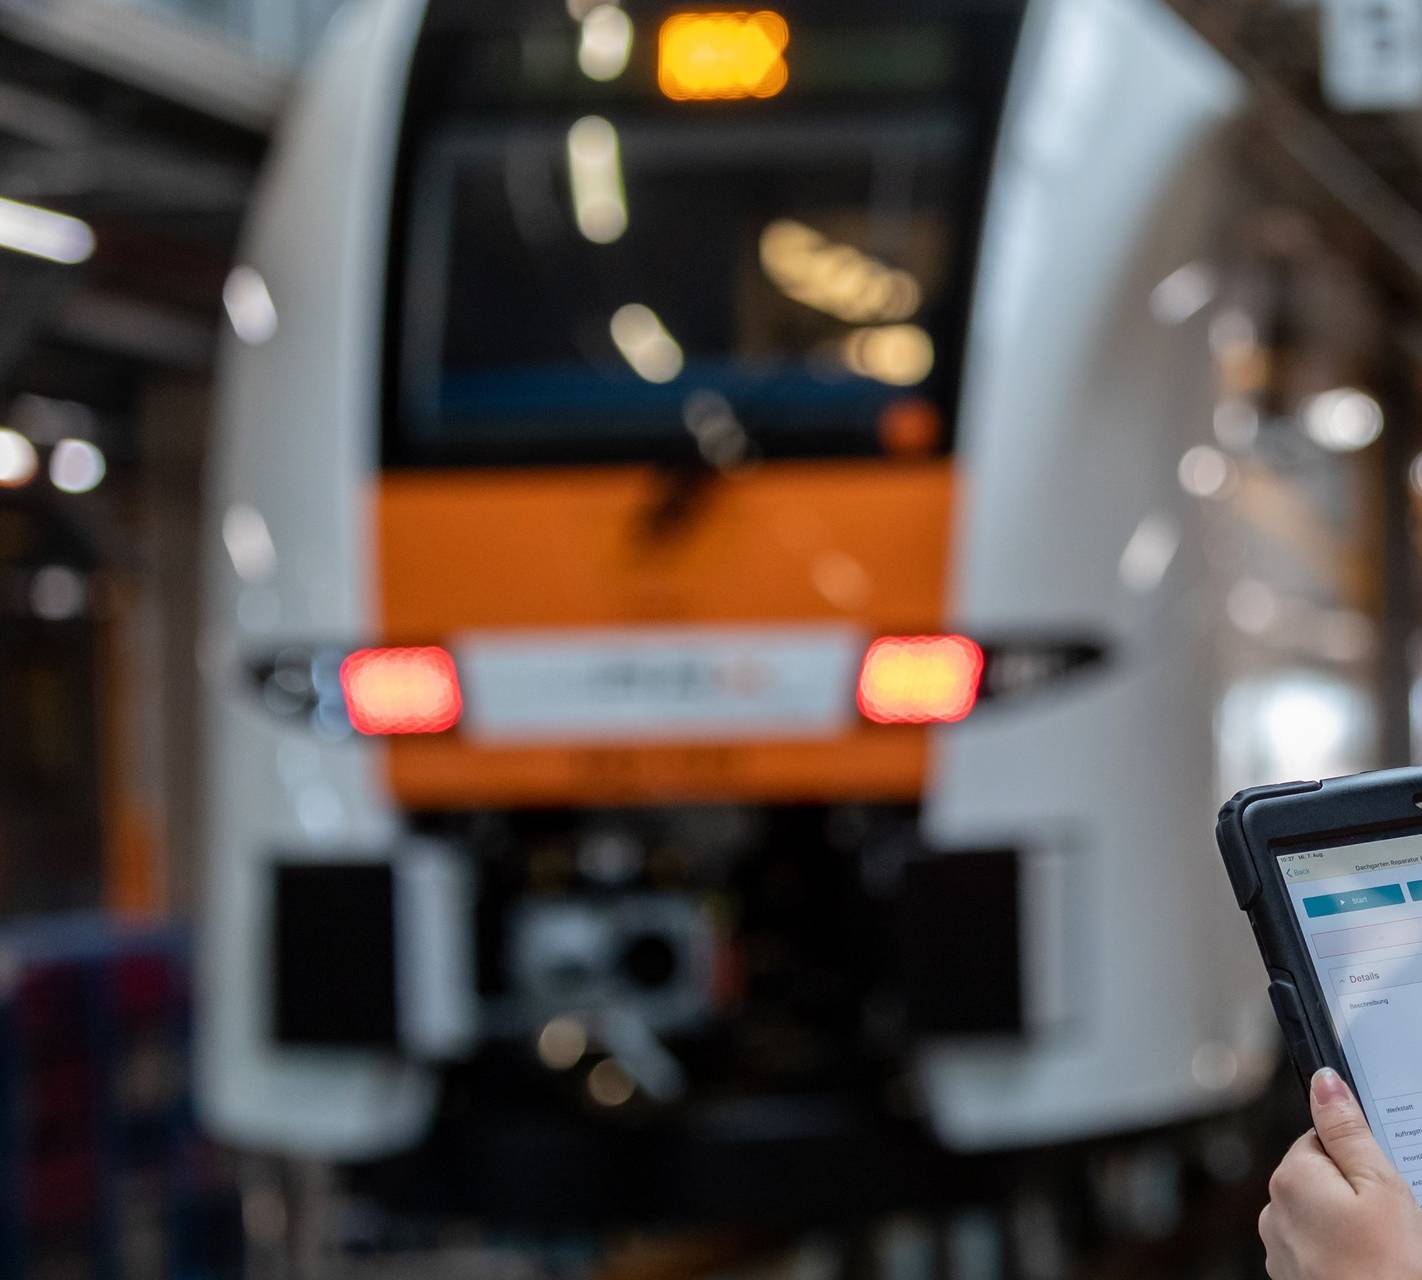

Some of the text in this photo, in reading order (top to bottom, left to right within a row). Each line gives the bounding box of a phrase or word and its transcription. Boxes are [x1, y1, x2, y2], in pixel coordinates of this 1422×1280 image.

[1354, 861, 1389, 870] Dachgarten
[1389, 856, 1418, 865] Reparatur
[1293, 867, 1310, 876] Back
[1351, 895, 1368, 904] Start
[1349, 971, 1379, 983] Details
[1349, 998, 1389, 1009] Beschreibung
[1385, 1103, 1413, 1113] Werkstatt
